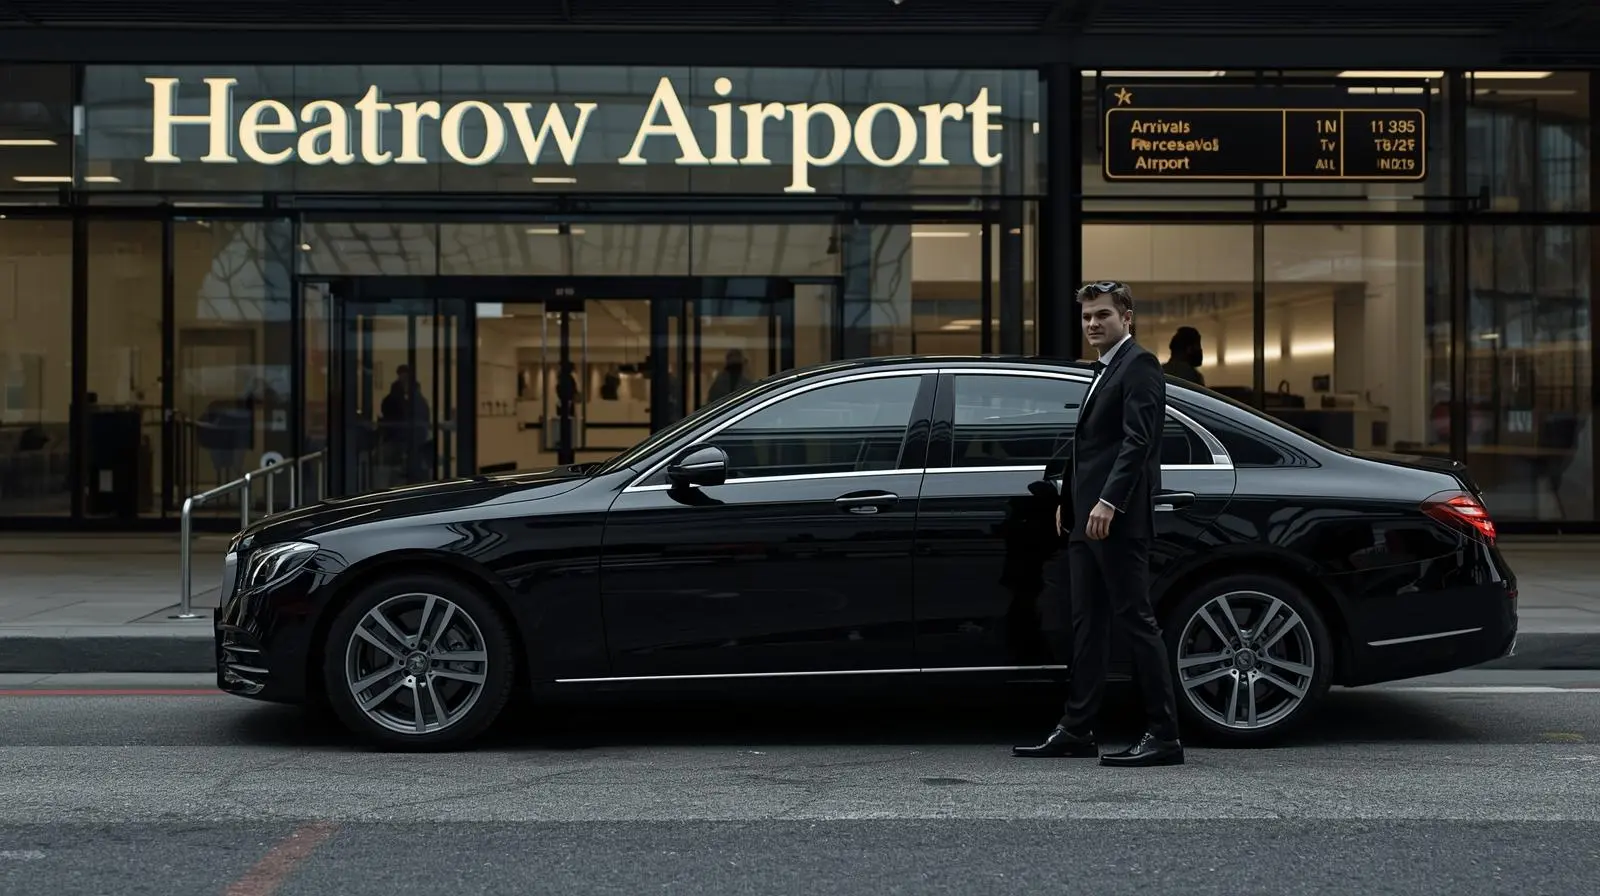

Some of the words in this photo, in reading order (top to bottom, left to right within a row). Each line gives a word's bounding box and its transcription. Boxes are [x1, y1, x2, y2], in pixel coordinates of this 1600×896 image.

[145, 77, 597, 166] Heatrow
[618, 77, 1003, 193] Airport
[1130, 119, 1191, 134] Arrivals
